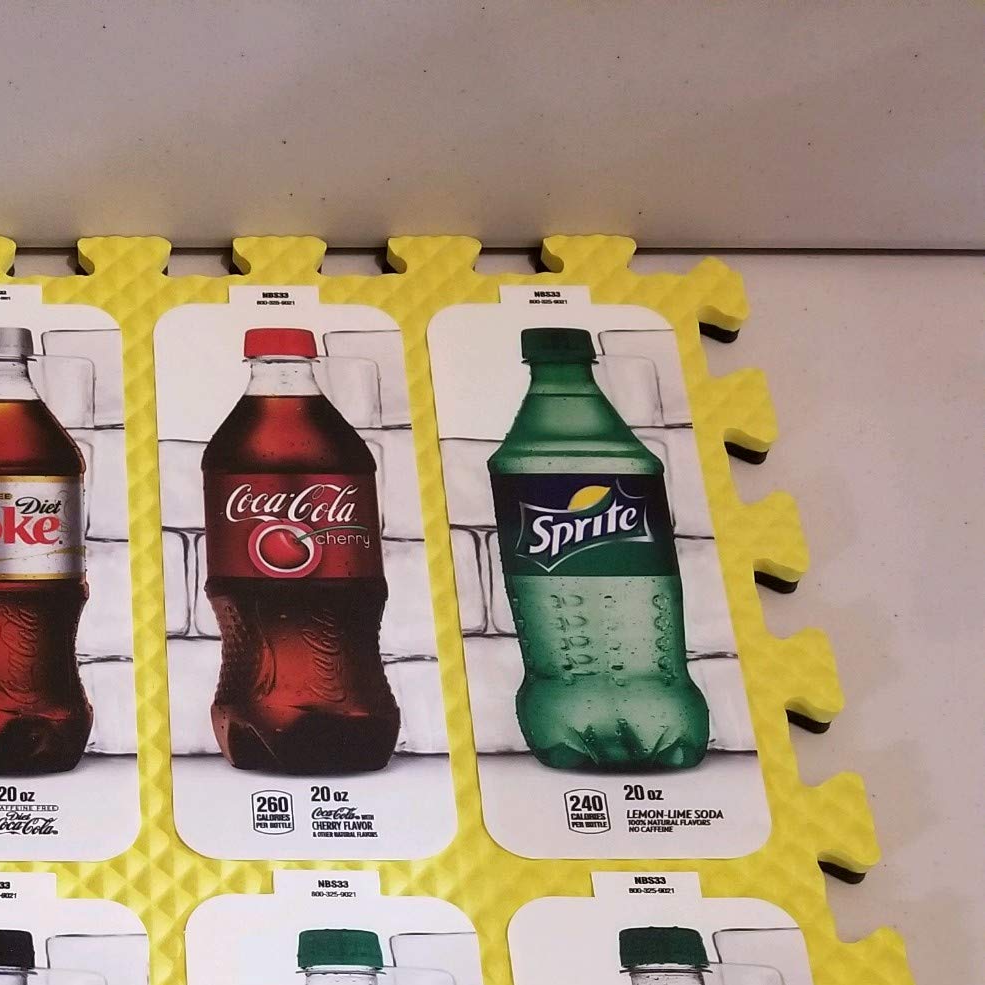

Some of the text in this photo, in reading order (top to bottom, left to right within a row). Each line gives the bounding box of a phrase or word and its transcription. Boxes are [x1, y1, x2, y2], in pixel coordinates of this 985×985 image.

[15, 497, 62, 514] Diet
[226, 483, 358, 522] Coca-Cola
[529, 498, 638, 557] Sprite
[315, 532, 369, 548] cherry
[20, 792, 35, 802] oz
[311, 786, 349, 801] 20 oz
[624, 785, 664, 800] 20 oz
[257, 796, 289, 812] 260
[570, 795, 603, 812] 240
[627, 810, 723, 819] LEMON-LIME SODA
[312, 822, 373, 830] CHERRY FLAVOR
[318, 880, 349, 888] NBS33
